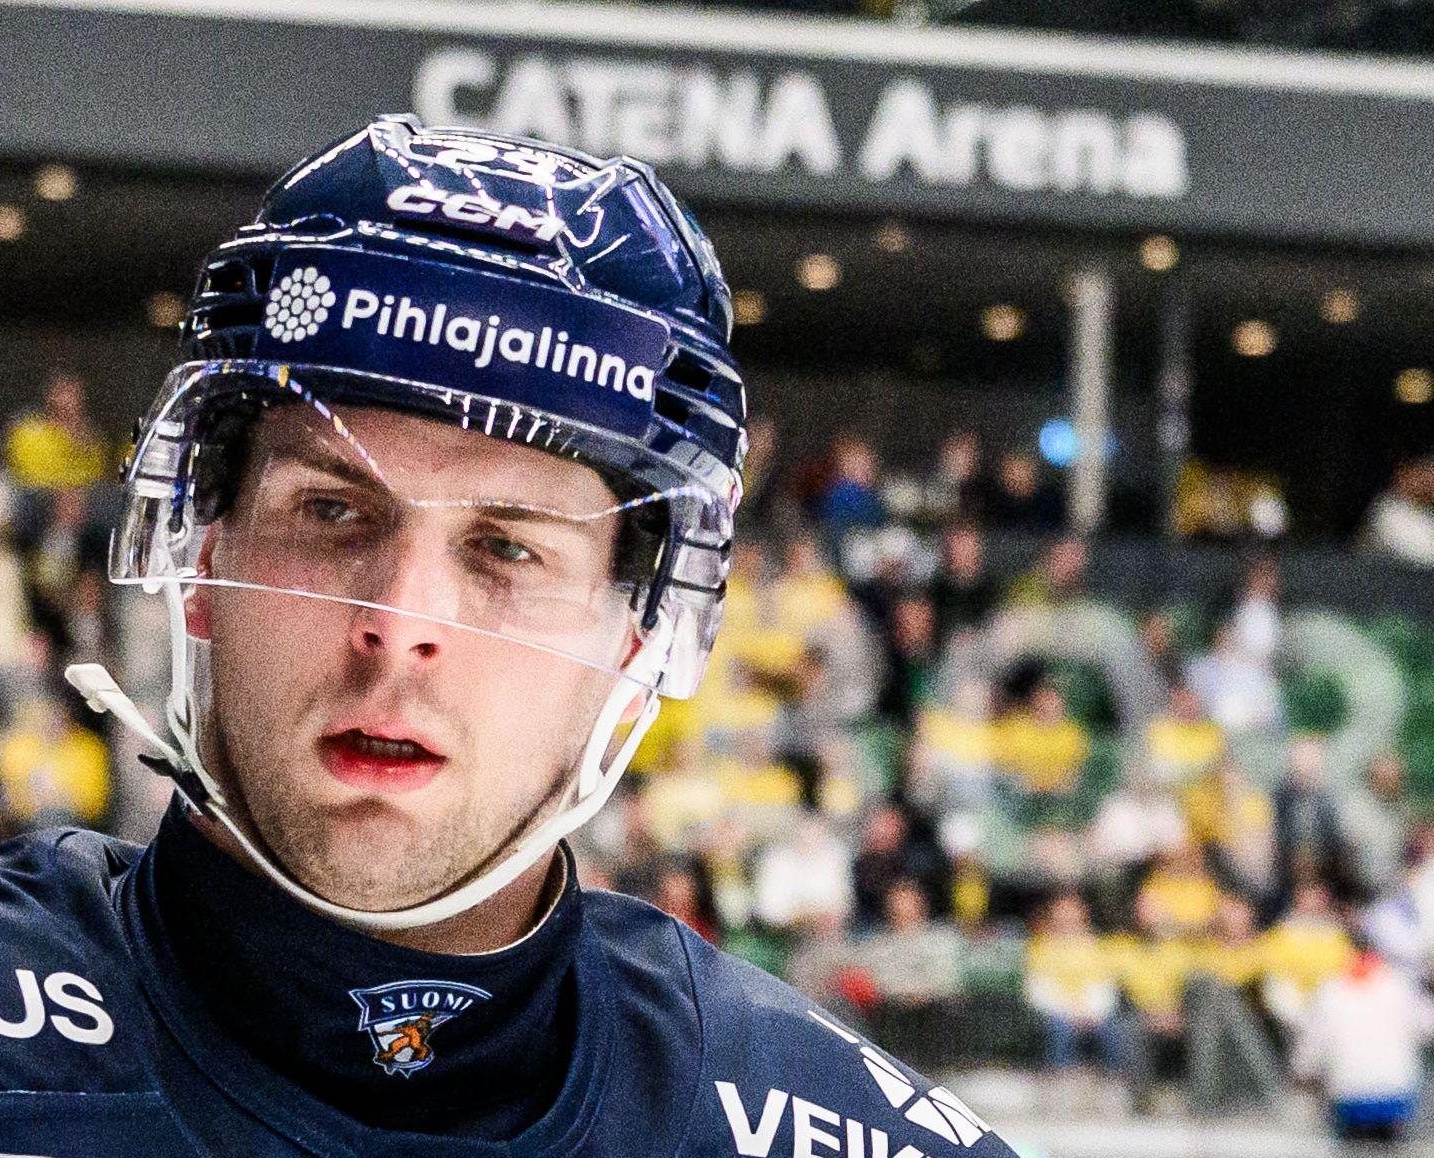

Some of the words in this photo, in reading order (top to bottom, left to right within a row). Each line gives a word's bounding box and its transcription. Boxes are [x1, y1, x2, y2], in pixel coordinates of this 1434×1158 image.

[859, 78, 1189, 197] Arena
[387, 185, 565, 241] CCM
[342, 289, 655, 403] Pihlajalinna
[380, 990, 474, 1013] SUOMI
